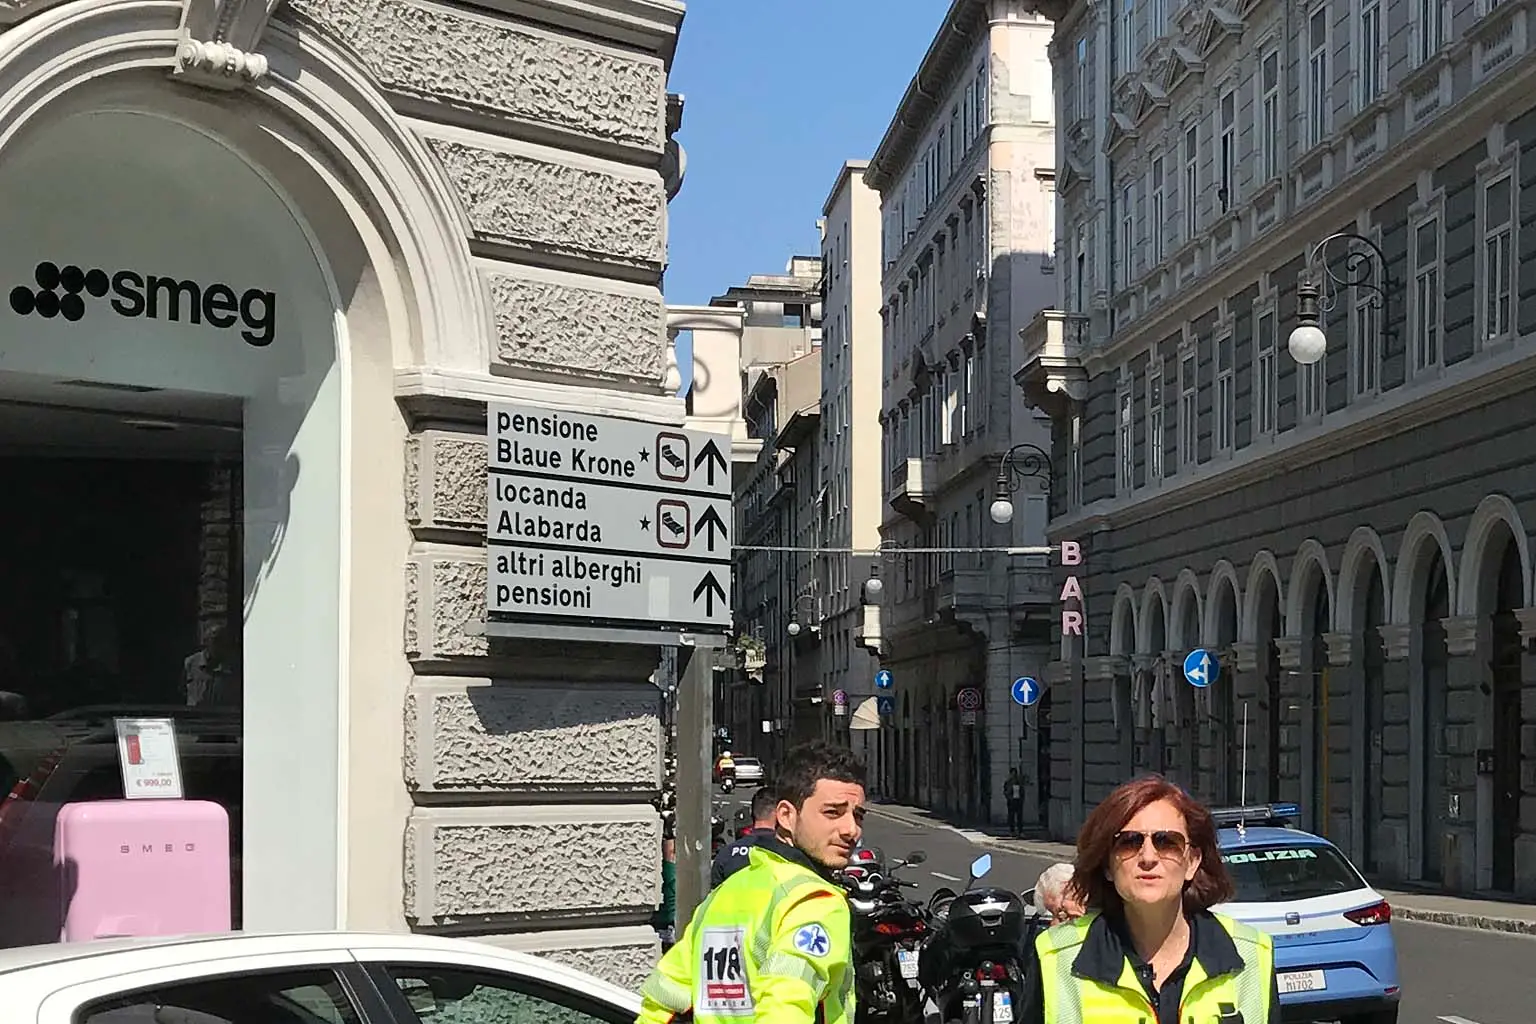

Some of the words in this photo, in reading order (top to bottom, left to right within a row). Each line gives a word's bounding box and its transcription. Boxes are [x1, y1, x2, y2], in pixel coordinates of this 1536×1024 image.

[110, 270, 276, 347] smeg
[497, 411, 598, 442] pensione
[497, 438, 562, 469] Blaue
[572, 448, 635, 477] Krone
[496, 477, 587, 510] locanda
[496, 510, 602, 543] Alabarda
[497, 551, 544, 576] altri
[552, 555, 641, 587] alberghi
[497, 583, 592, 609] pensioni
[1060, 541, 1083, 635] BAR
[703, 946, 741, 981] 118
